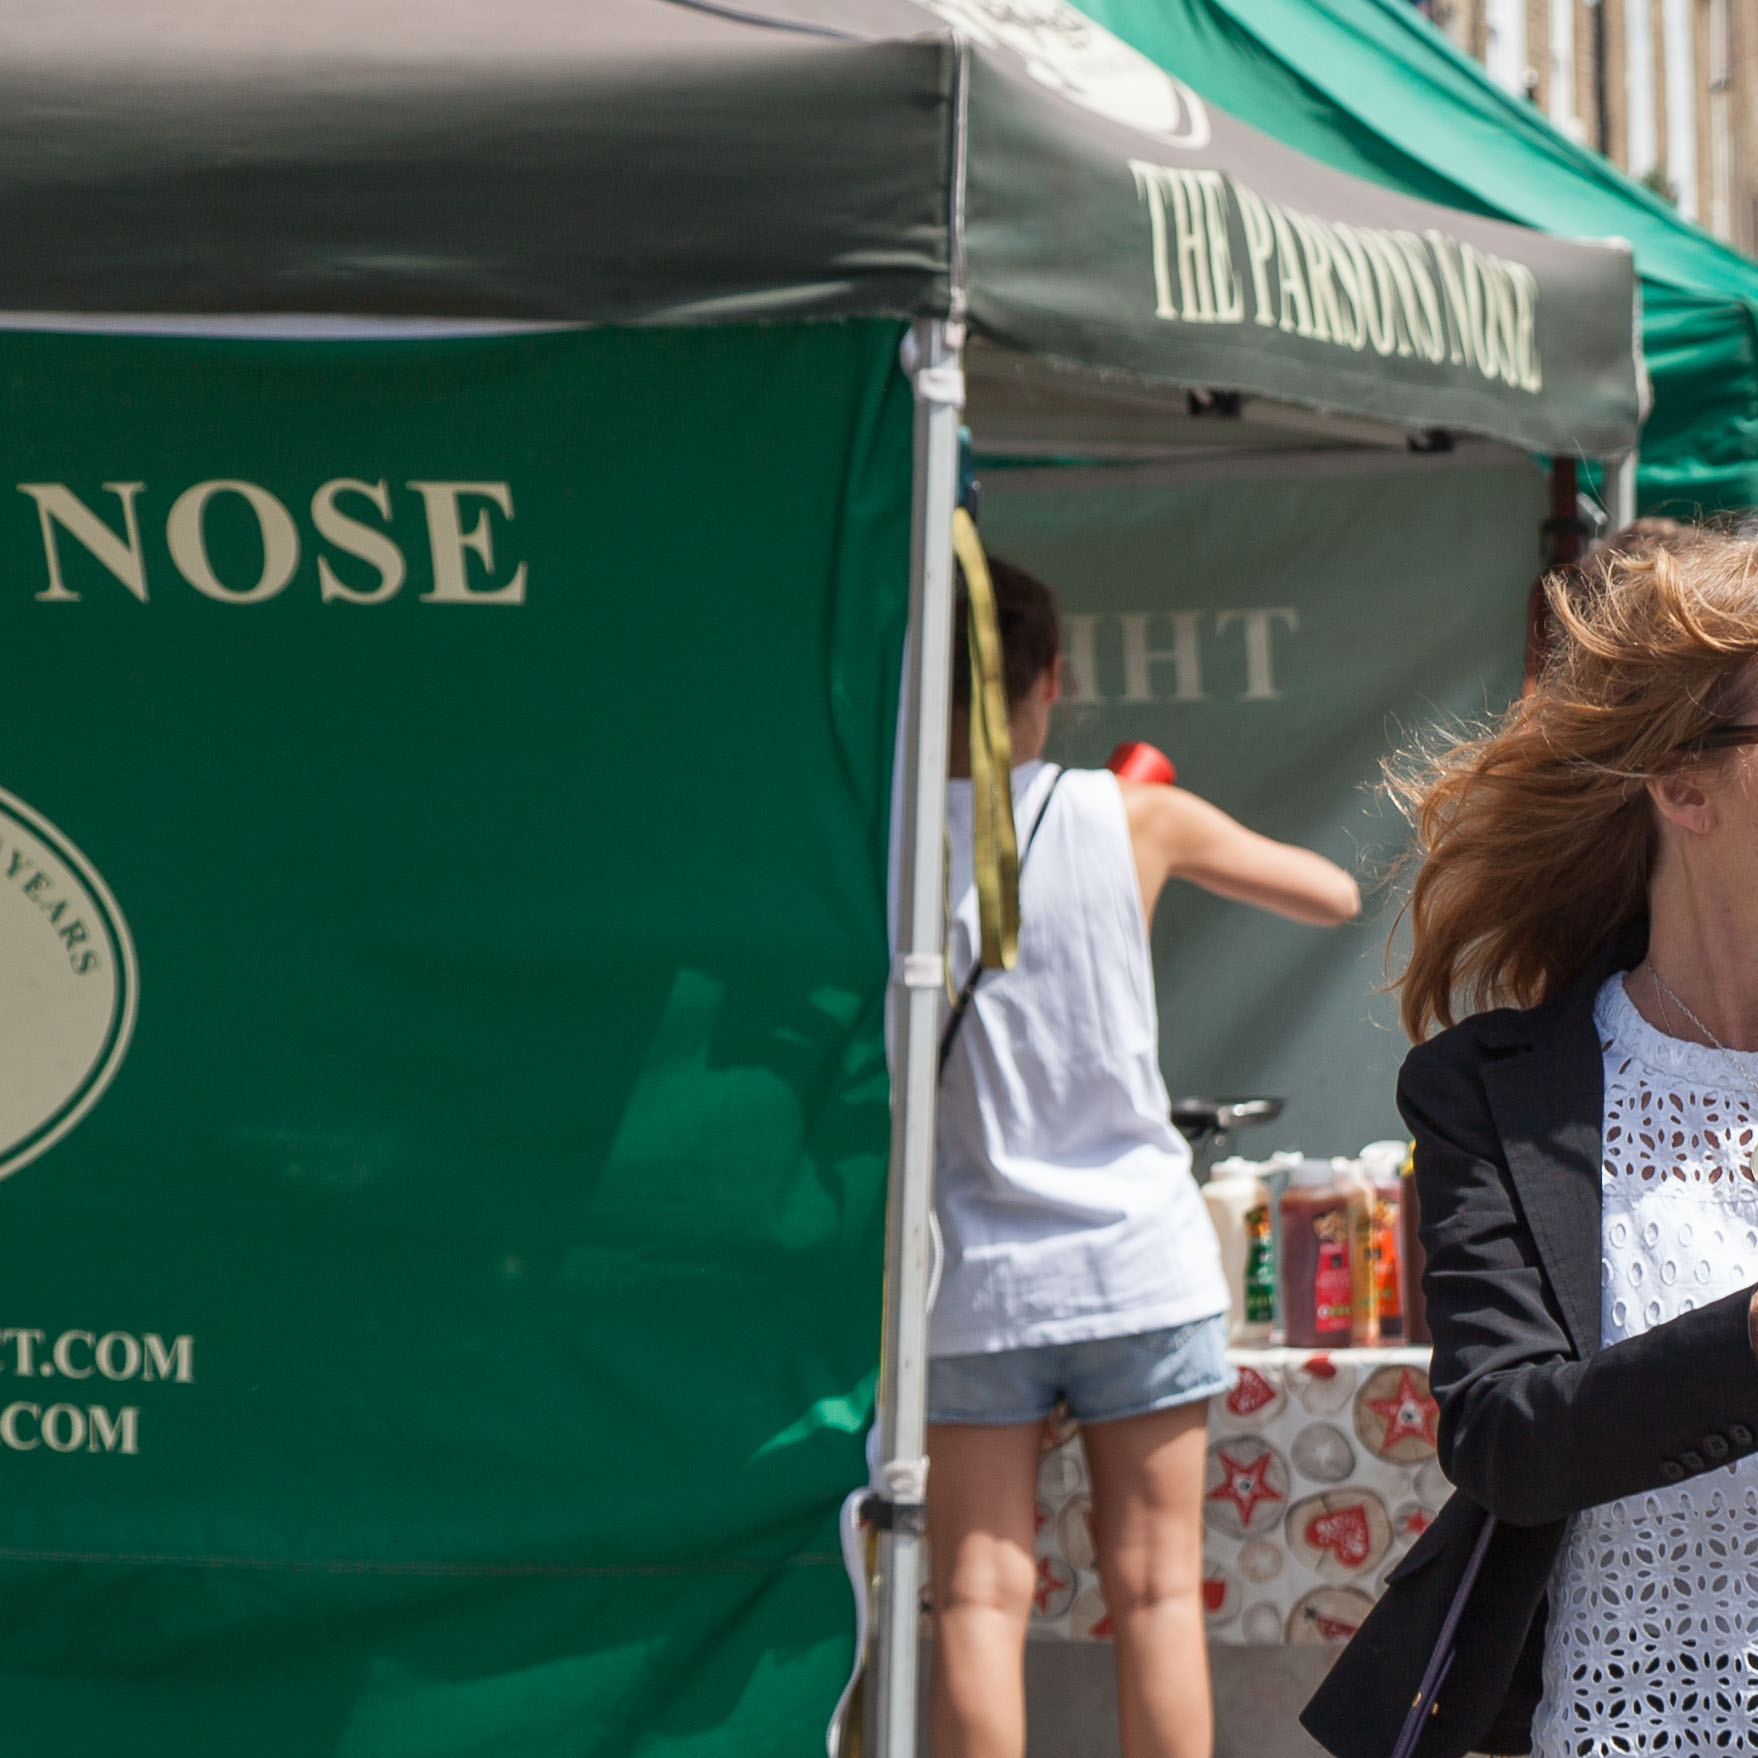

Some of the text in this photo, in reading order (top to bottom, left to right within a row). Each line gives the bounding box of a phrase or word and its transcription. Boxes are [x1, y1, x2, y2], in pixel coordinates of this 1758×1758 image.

[1129, 160, 1245, 324] THE
[1424, 229, 1543, 395] NOSE
[16, 476, 528, 606] NOSE
[6, 848, 99, 976] YEARS
[0, 1327, 196, 1384] T.COM
